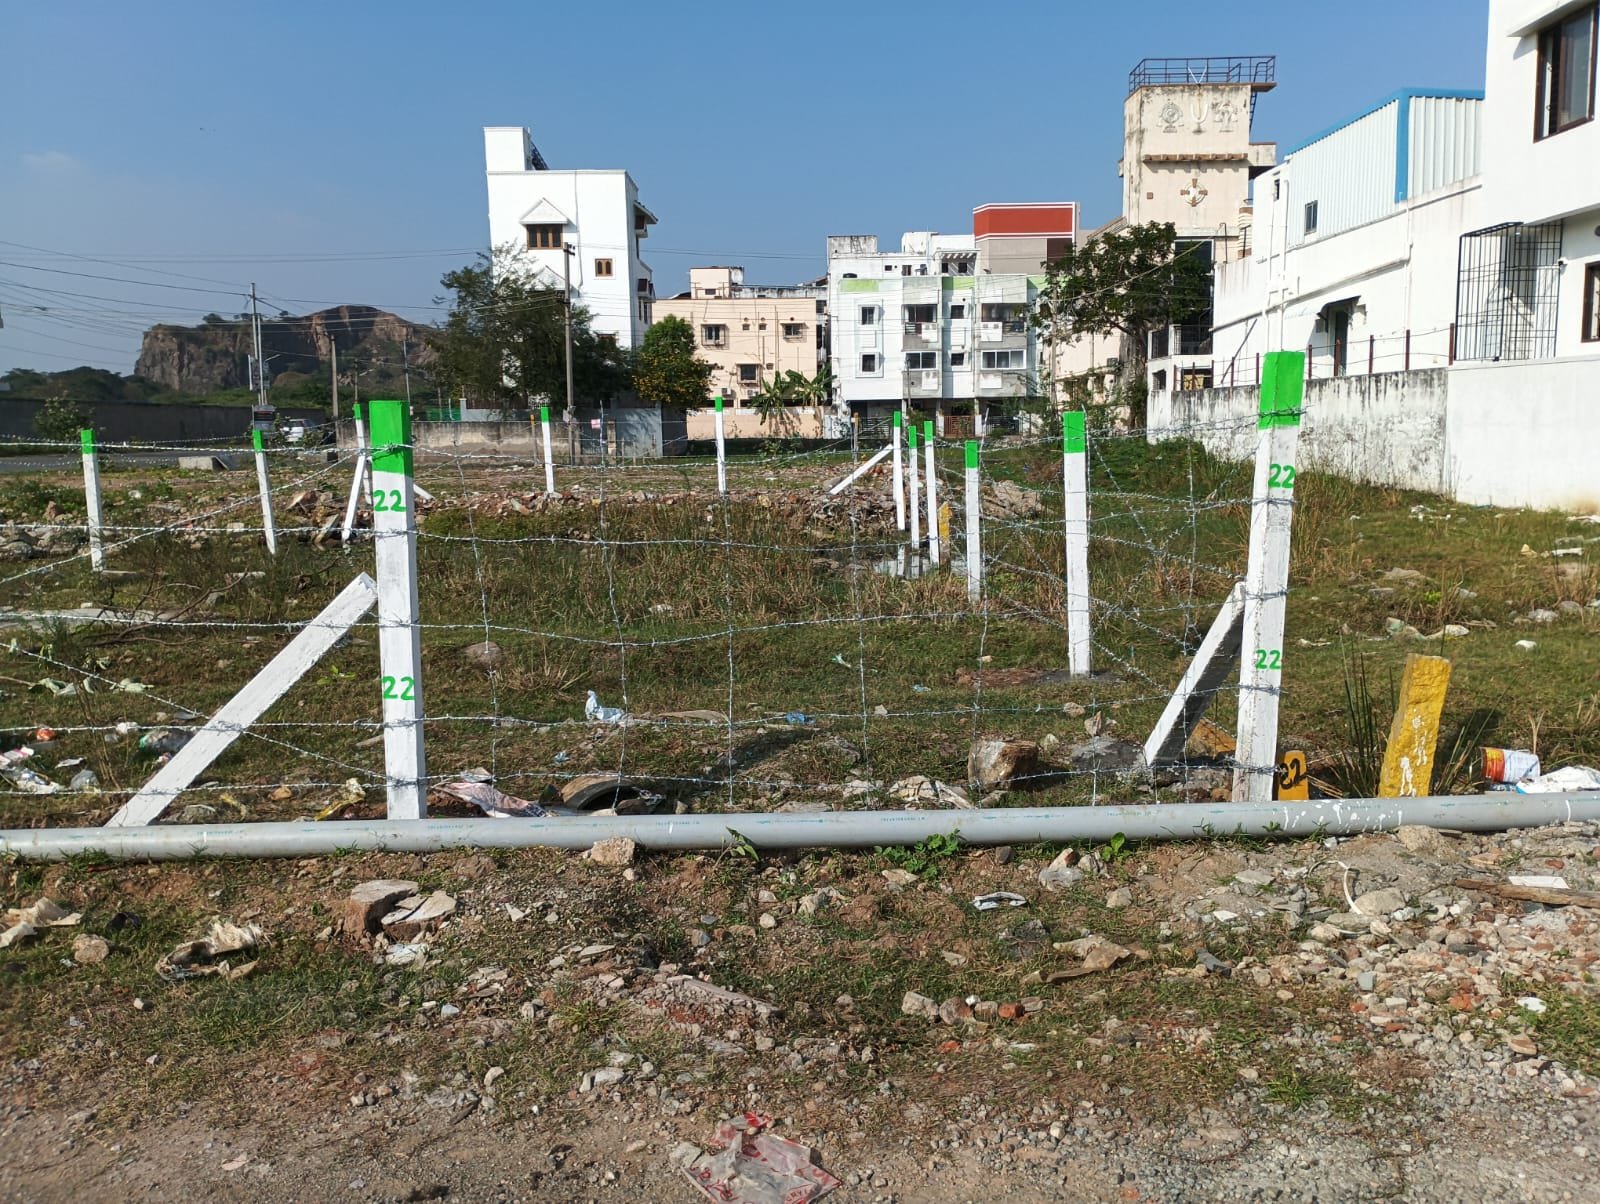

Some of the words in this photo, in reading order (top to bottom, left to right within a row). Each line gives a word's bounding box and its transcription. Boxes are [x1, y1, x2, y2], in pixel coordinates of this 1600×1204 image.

[1268, 463, 1296, 488] 22
[373, 489, 407, 512] 22
[1255, 649, 1281, 670] 22
[382, 675, 416, 700] 22
